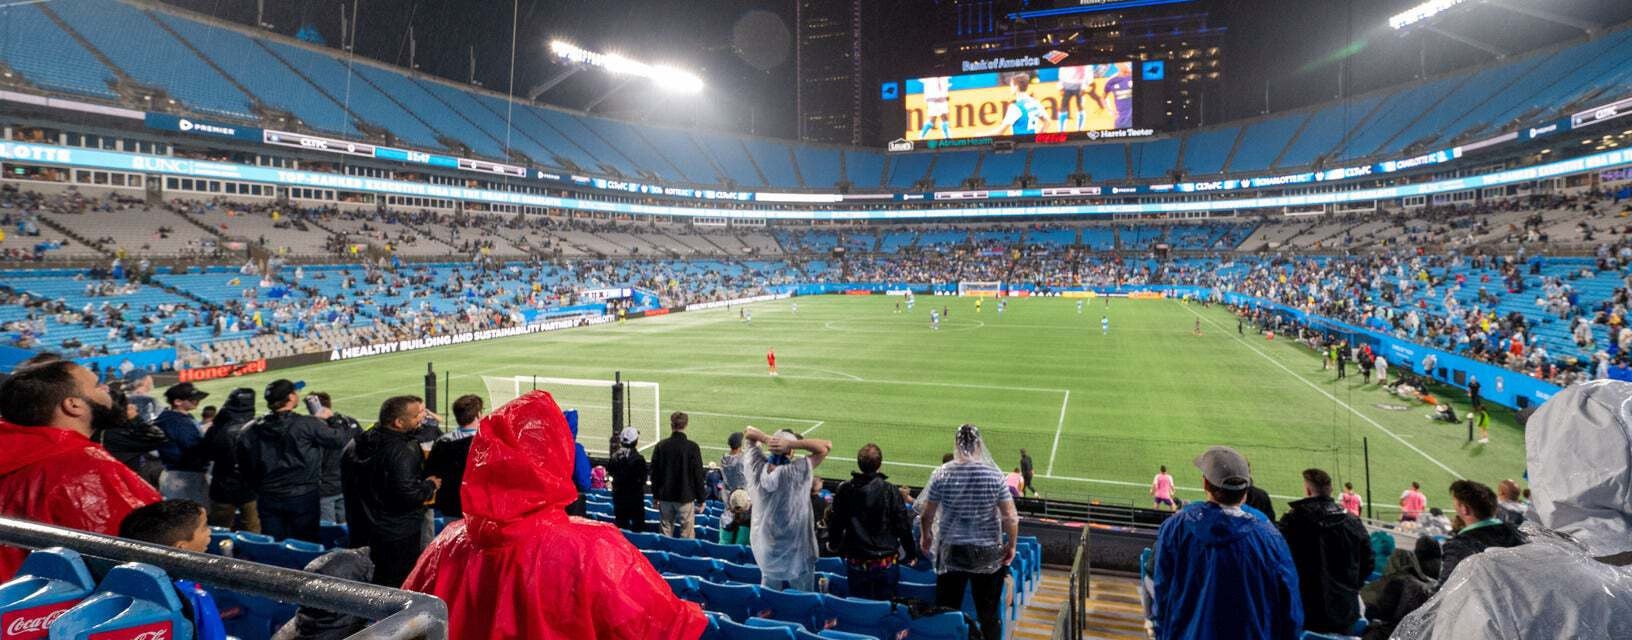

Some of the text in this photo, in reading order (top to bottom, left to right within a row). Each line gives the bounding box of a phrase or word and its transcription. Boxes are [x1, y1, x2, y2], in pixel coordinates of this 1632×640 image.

[962, 56, 1040, 71] Bank of America
[194, 123, 236, 136] PREMIER
[1100, 128, 1154, 138] Harris Teeter
[147, 158, 190, 174] UNC
[330, 349, 341, 361] A
[342, 341, 398, 359] HEALTHY
[399, 335, 452, 351] BUILDING
[451, 331, 473, 344] AND
[474, 323, 540, 341] SUSTAINABILITY
[541, 319, 573, 331] PARTNER
[178, 357, 267, 383] Honeell
